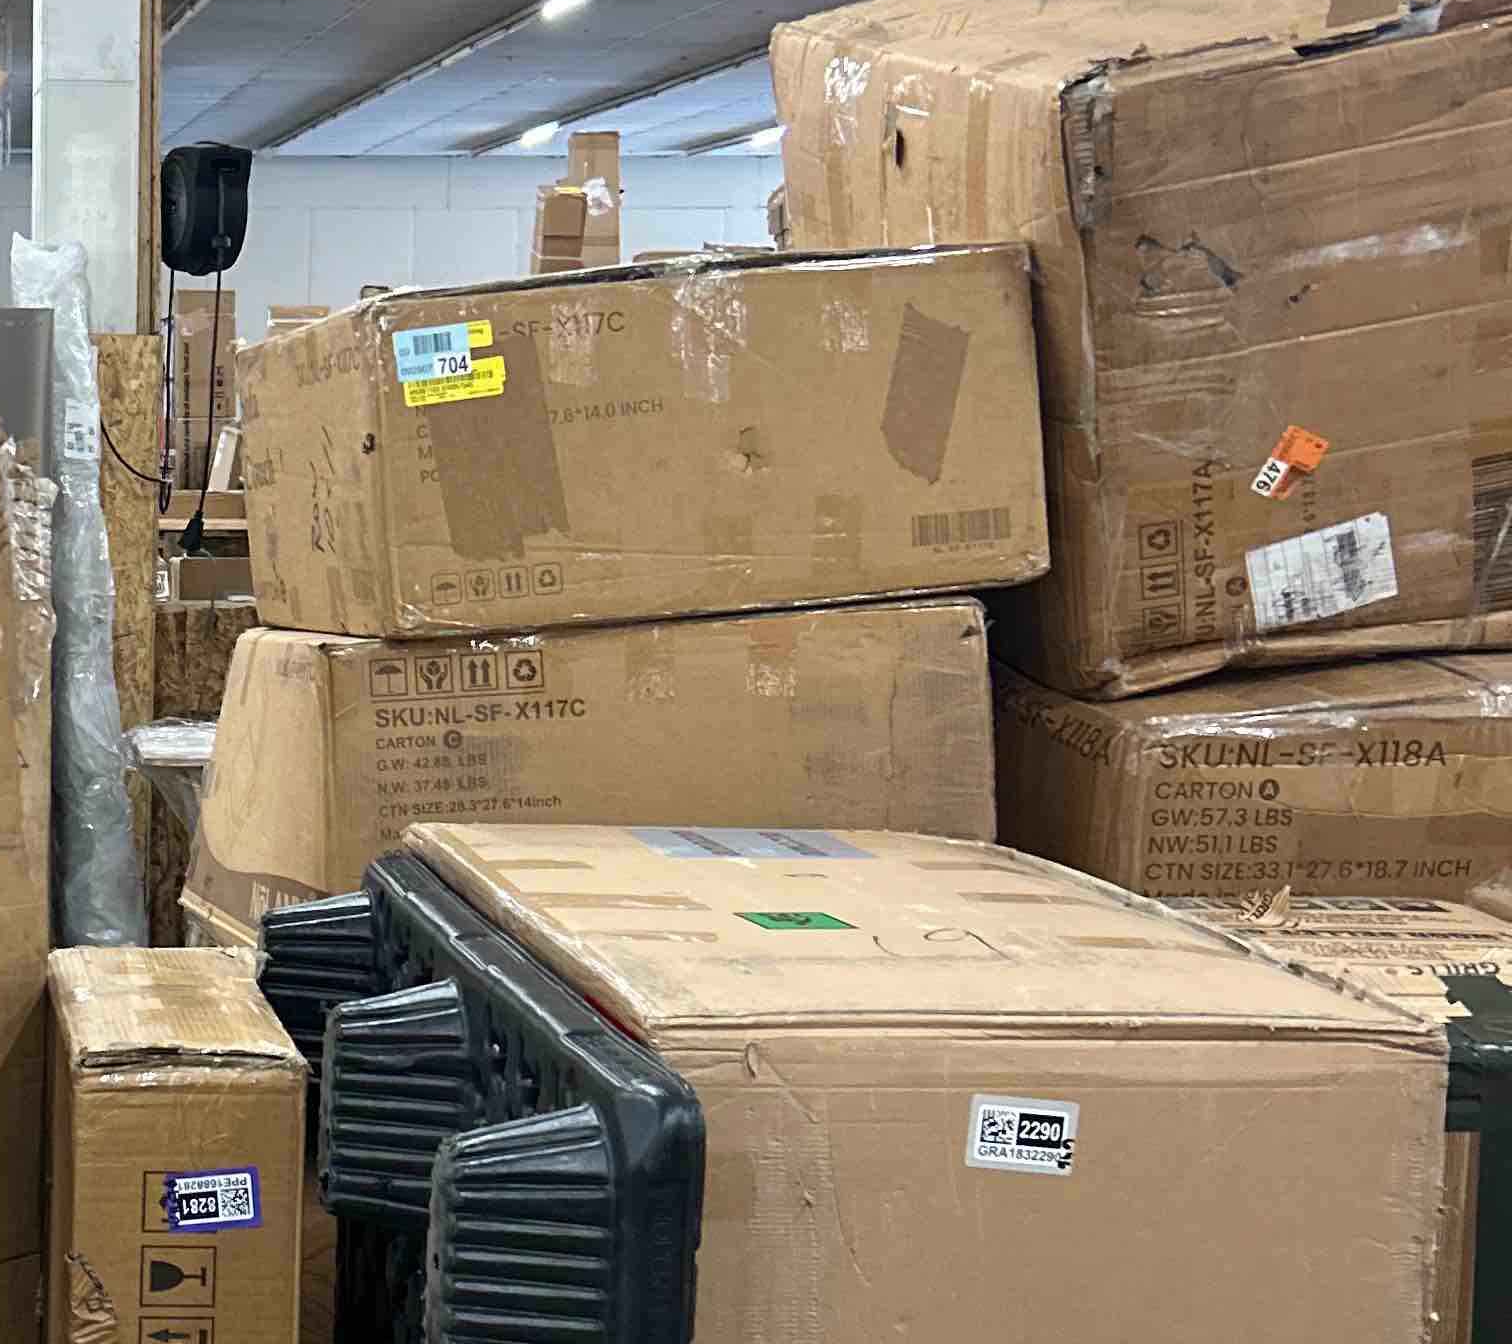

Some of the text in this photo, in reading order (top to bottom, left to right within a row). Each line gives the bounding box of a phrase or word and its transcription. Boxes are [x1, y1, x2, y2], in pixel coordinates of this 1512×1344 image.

[499, 311, 626, 338] -SF-X117C
[437, 355, 469, 374] 704
[619, 399, 665, 416] INCH
[1256, 460, 1281, 491] 476
[1193, 461, 1215, 639] U:NL-SF-X117A
[375, 698, 586, 728] SKU:NL-SF-X117C
[375, 736, 437, 750] CARTON
[457, 753, 488, 767] LBS
[1158, 739, 1447, 769] SKU:NL-SF-X118A
[457, 776, 488, 790] LBS
[1154, 781, 1253, 800] CARTON
[378, 804, 408, 818] CTN
[1151, 809, 1294, 828] GW:57.3 LBS
[1239, 835, 1278, 853] LBS
[1144, 862, 1194, 881] CTN
[1413, 858, 1473, 878] INCH
[1019, 1119, 1061, 1142] 2290
[978, 1145, 1062, 1162] GRA1832290
[181, 1196, 217, 1216] 8281
